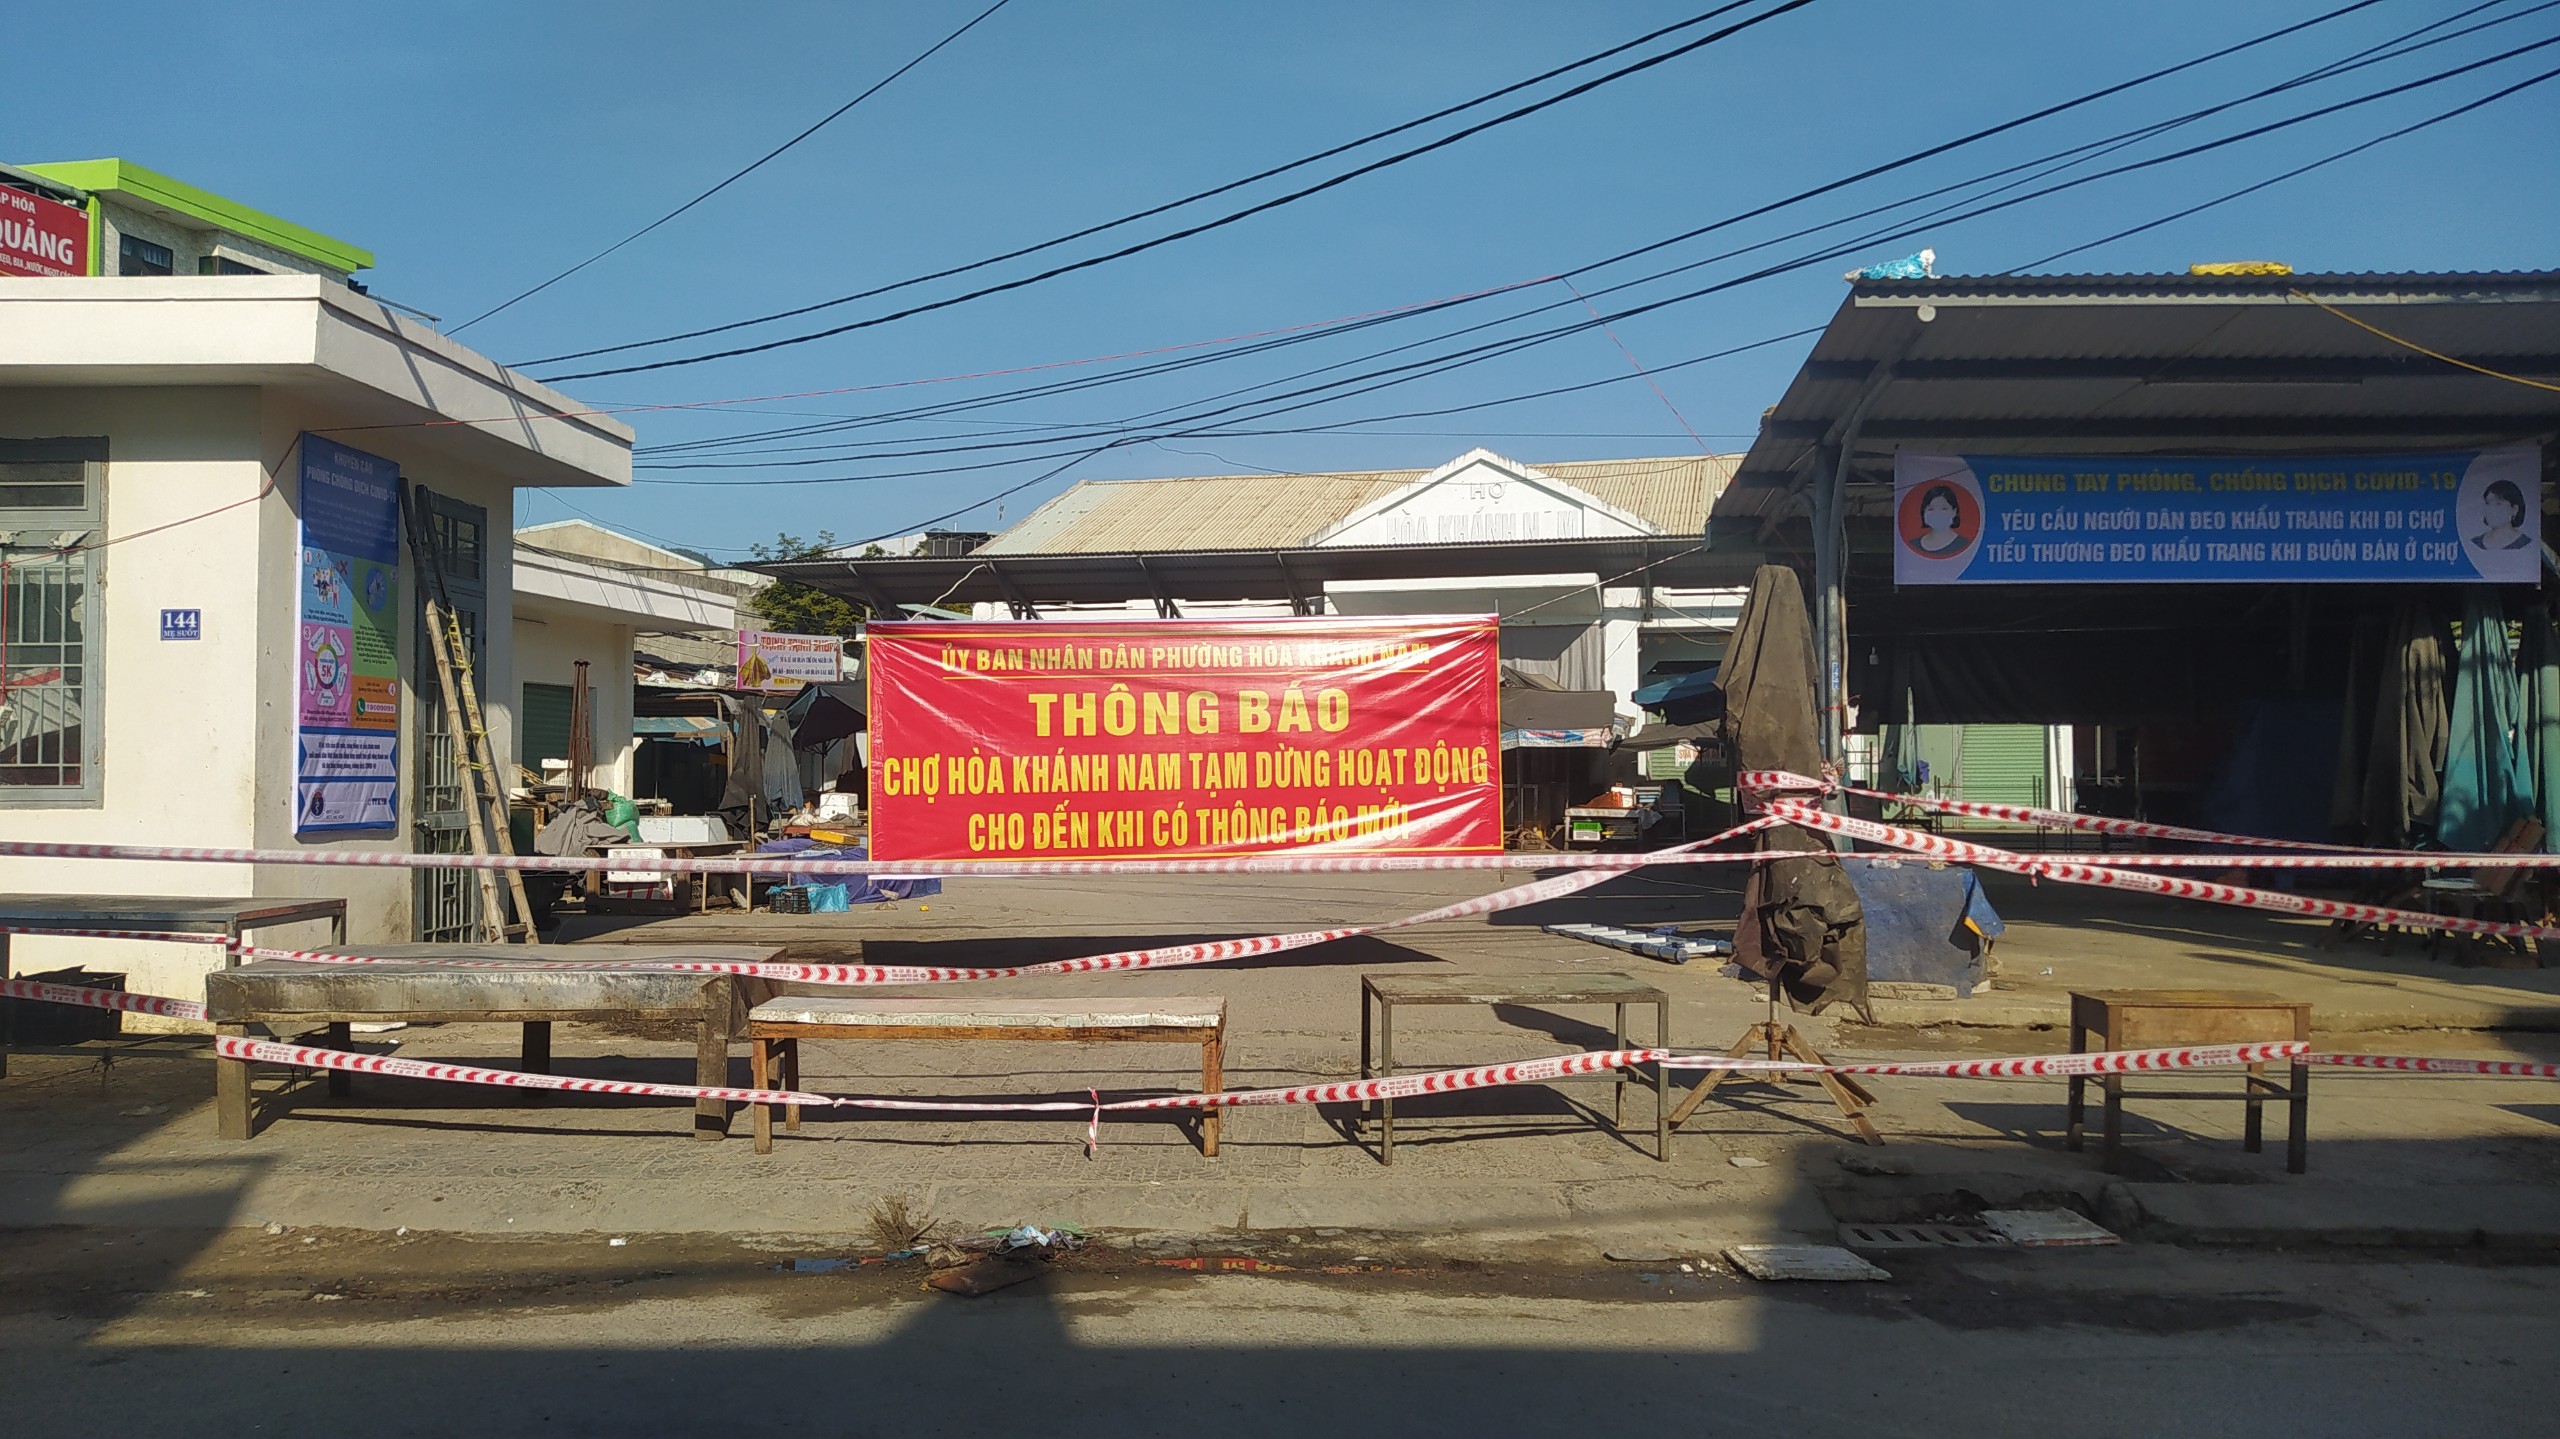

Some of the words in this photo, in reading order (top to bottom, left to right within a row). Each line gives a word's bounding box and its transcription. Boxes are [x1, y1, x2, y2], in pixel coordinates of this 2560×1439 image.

[0, 217, 73, 266] UẢNG
[1989, 473, 2066, 493] CHUNG
[2074, 473, 2109, 492] TAY
[2117, 468, 2202, 493] PHÒNG,
[2210, 466, 2287, 491] CHỐNG
[2294, 472, 2347, 495] DỊCH
[2354, 472, 2457, 491] COVID-19
[2001, 508, 2035, 531] YÊU
[2084, 507, 2141, 531] NGƯỜI
[2146, 507, 2184, 530] DÂN
[2190, 510, 2225, 530] ĐEO
[2231, 504, 2280, 530] KHẨU
[2285, 510, 2344, 530] TRANG
[2350, 510, 2379, 530] KHI
[2385, 510, 2403, 529] ĐI
[2408, 508, 2444, 533] CHỢ
[1987, 536, 2026, 562] TIỂU
[2032, 541, 2104, 562] THƯƠNG
[2110, 543, 2145, 562] ĐEO
[2151, 535, 2200, 561] KHẨU
[2206, 542, 2265, 562] TRANG
[2271, 543, 2301, 562] KHI
[2307, 538, 2356, 561] BUÔN
[2362, 538, 2399, 561] BÁN
[2404, 536, 2416, 561] Ở
[2422, 540, 2458, 565] CHỢ
[164, 612, 197, 628] 144
[942, 642, 969, 671] ỦY
[977, 649, 1023, 671] BAN
[1030, 643, 1093, 670] NHÂN
[1100, 643, 1145, 670] DÂN
[1152, 641, 1243, 669] PHƯỜNG
[1250, 641, 1294, 667] HÒA
[1028, 683, 1219, 737] THÔNG
[1238, 680, 1350, 733] BÁO
[884, 753, 940, 803] CHỢ
[948, 747, 1005, 794] HÒA
[1012, 747, 1108, 793] KHÁNH
[1117, 753, 1181, 792] NAM
[1189, 751, 1247, 798] TẠM
[1256, 743, 1330, 788] DỪNG
[1339, 748, 1407, 793] HOẠT
[1414, 740, 1488, 793] ĐỘNG
[969, 812, 1025, 851] CHO
[1033, 799, 1089, 849] ĐẾN
[1097, 810, 1144, 848] KHI
[1153, 801, 1188, 847] CÓ
[1196, 800, 1287, 845] THÔNG
[1295, 799, 1348, 843] BÁO
[1357, 796, 1409, 840] MỚI
